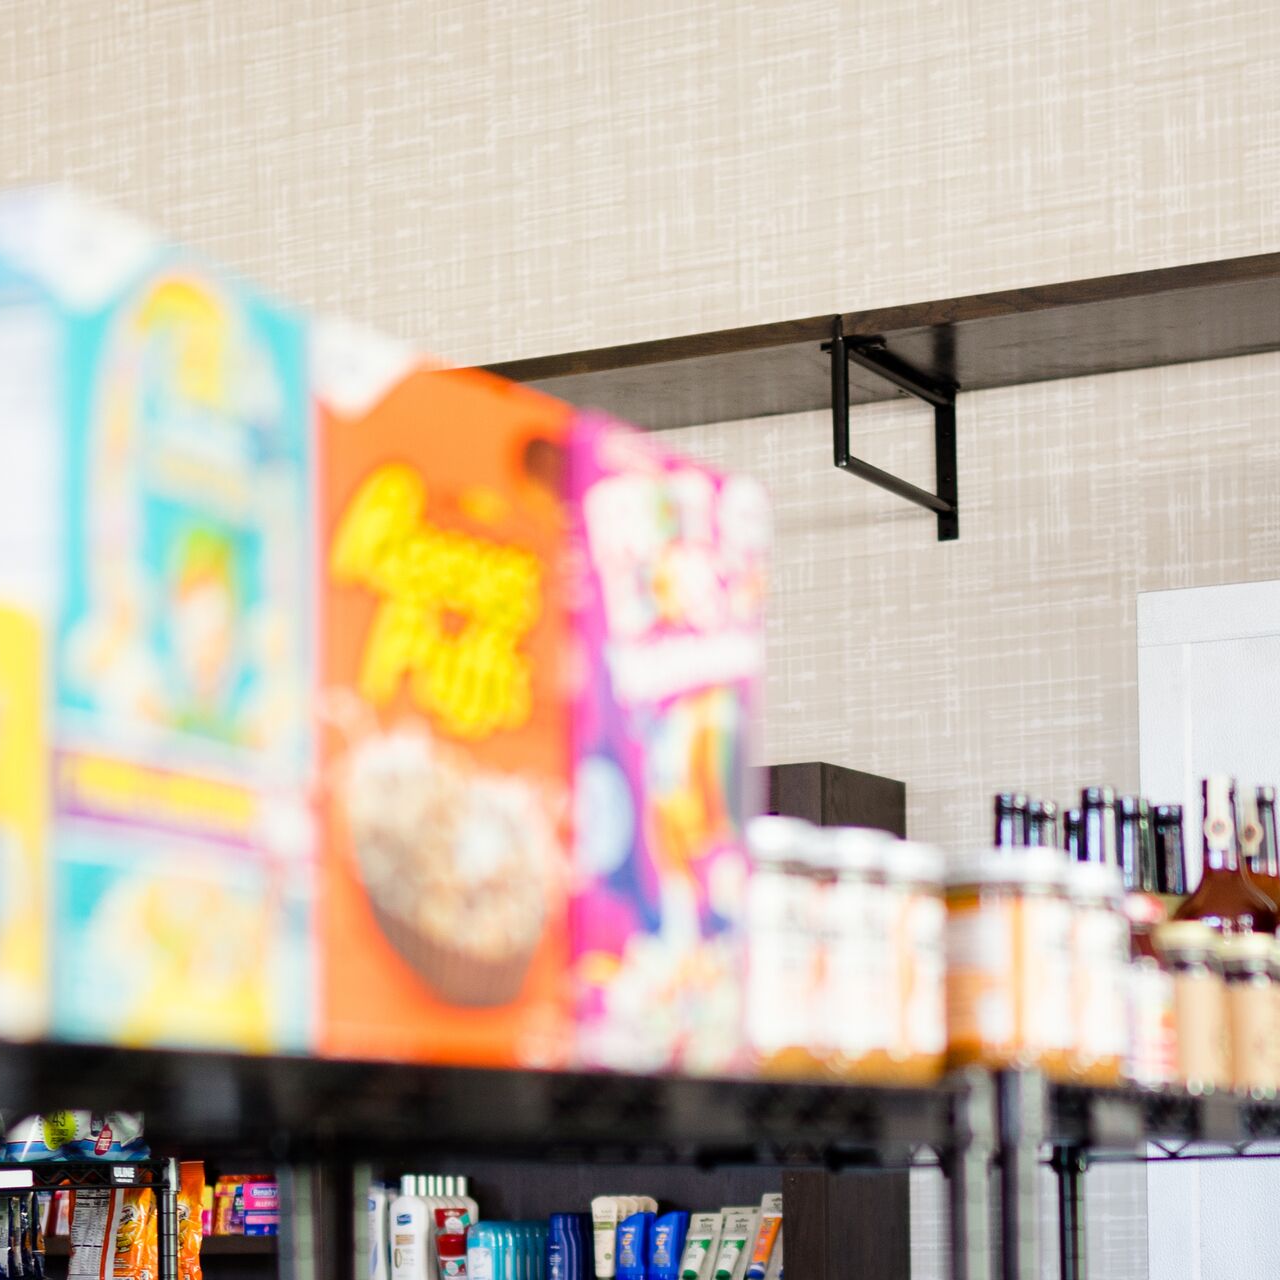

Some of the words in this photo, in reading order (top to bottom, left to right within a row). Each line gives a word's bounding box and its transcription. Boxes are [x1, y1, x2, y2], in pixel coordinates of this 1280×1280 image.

[113, 1166, 136, 1178] ULINE
[251, 1186, 278, 1196] Benadry
[253, 1199, 278, 1208] ALLERG
